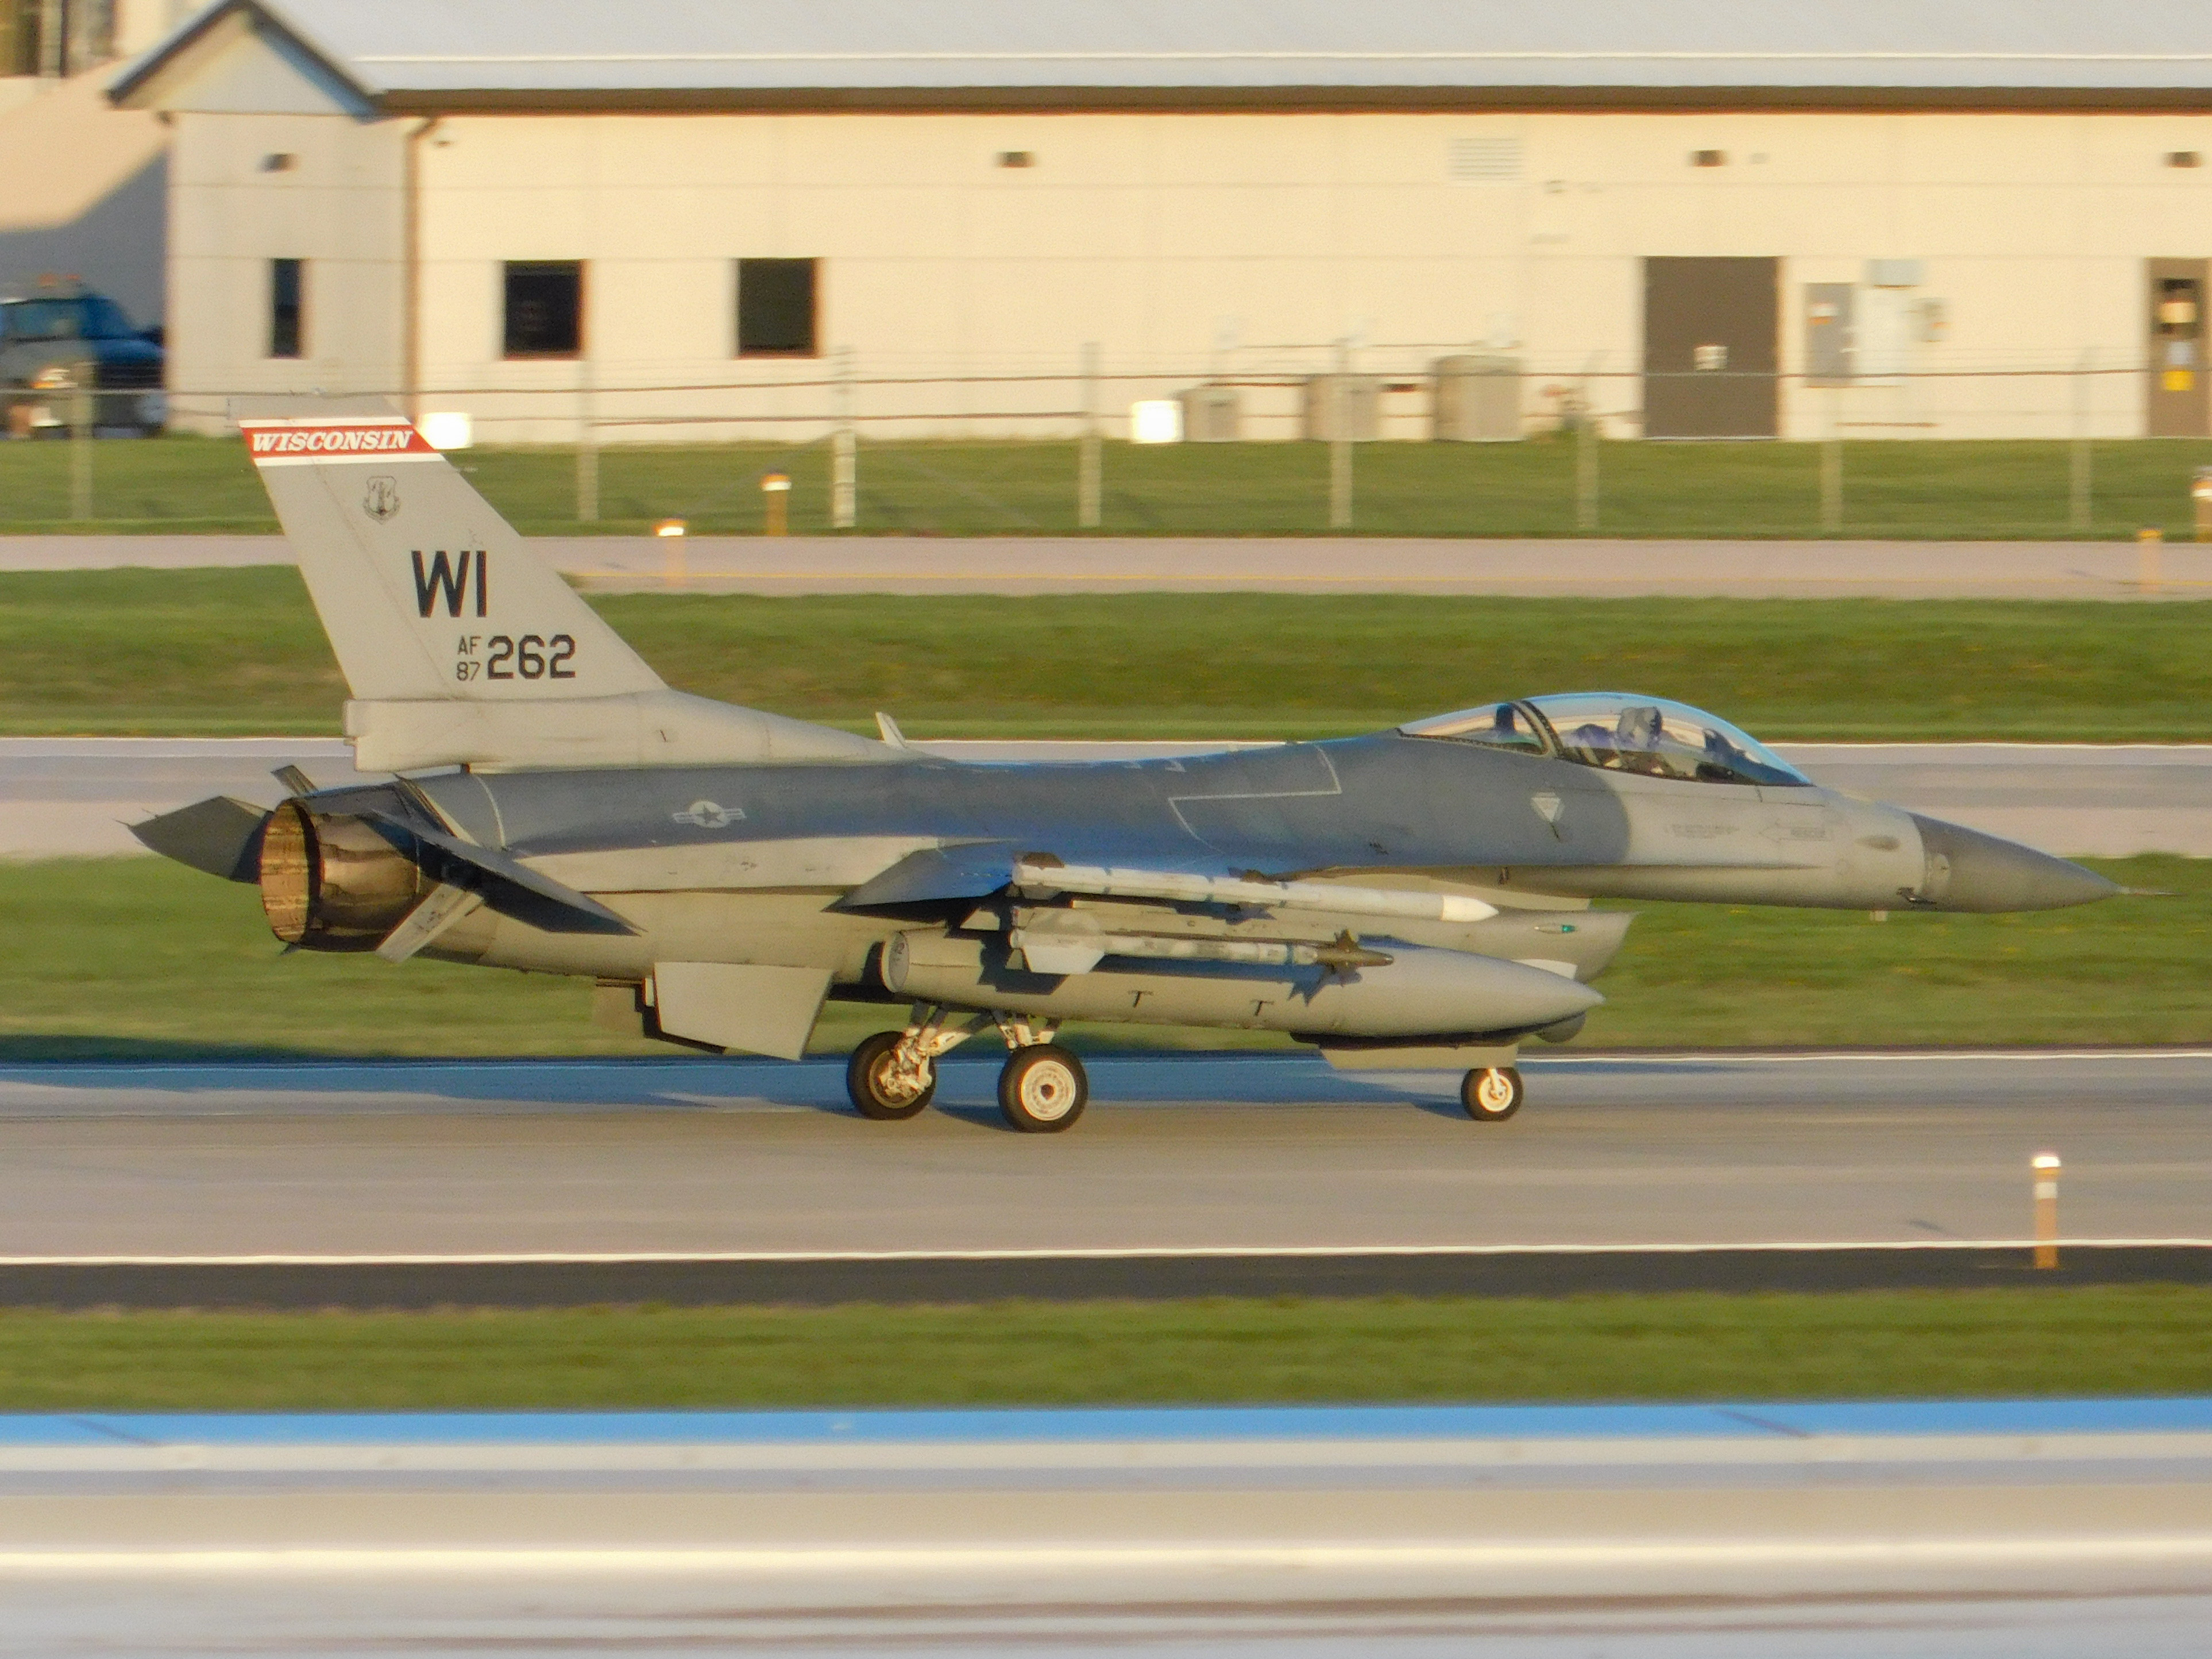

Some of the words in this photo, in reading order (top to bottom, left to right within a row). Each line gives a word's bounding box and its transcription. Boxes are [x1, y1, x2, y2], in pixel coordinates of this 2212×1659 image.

[253, 431, 413, 451] WISCONSIN
[411, 550, 487, 618] WI
[457, 635, 481, 655] AF
[488, 634, 576, 679] 262
[456, 661, 481, 681] 87
